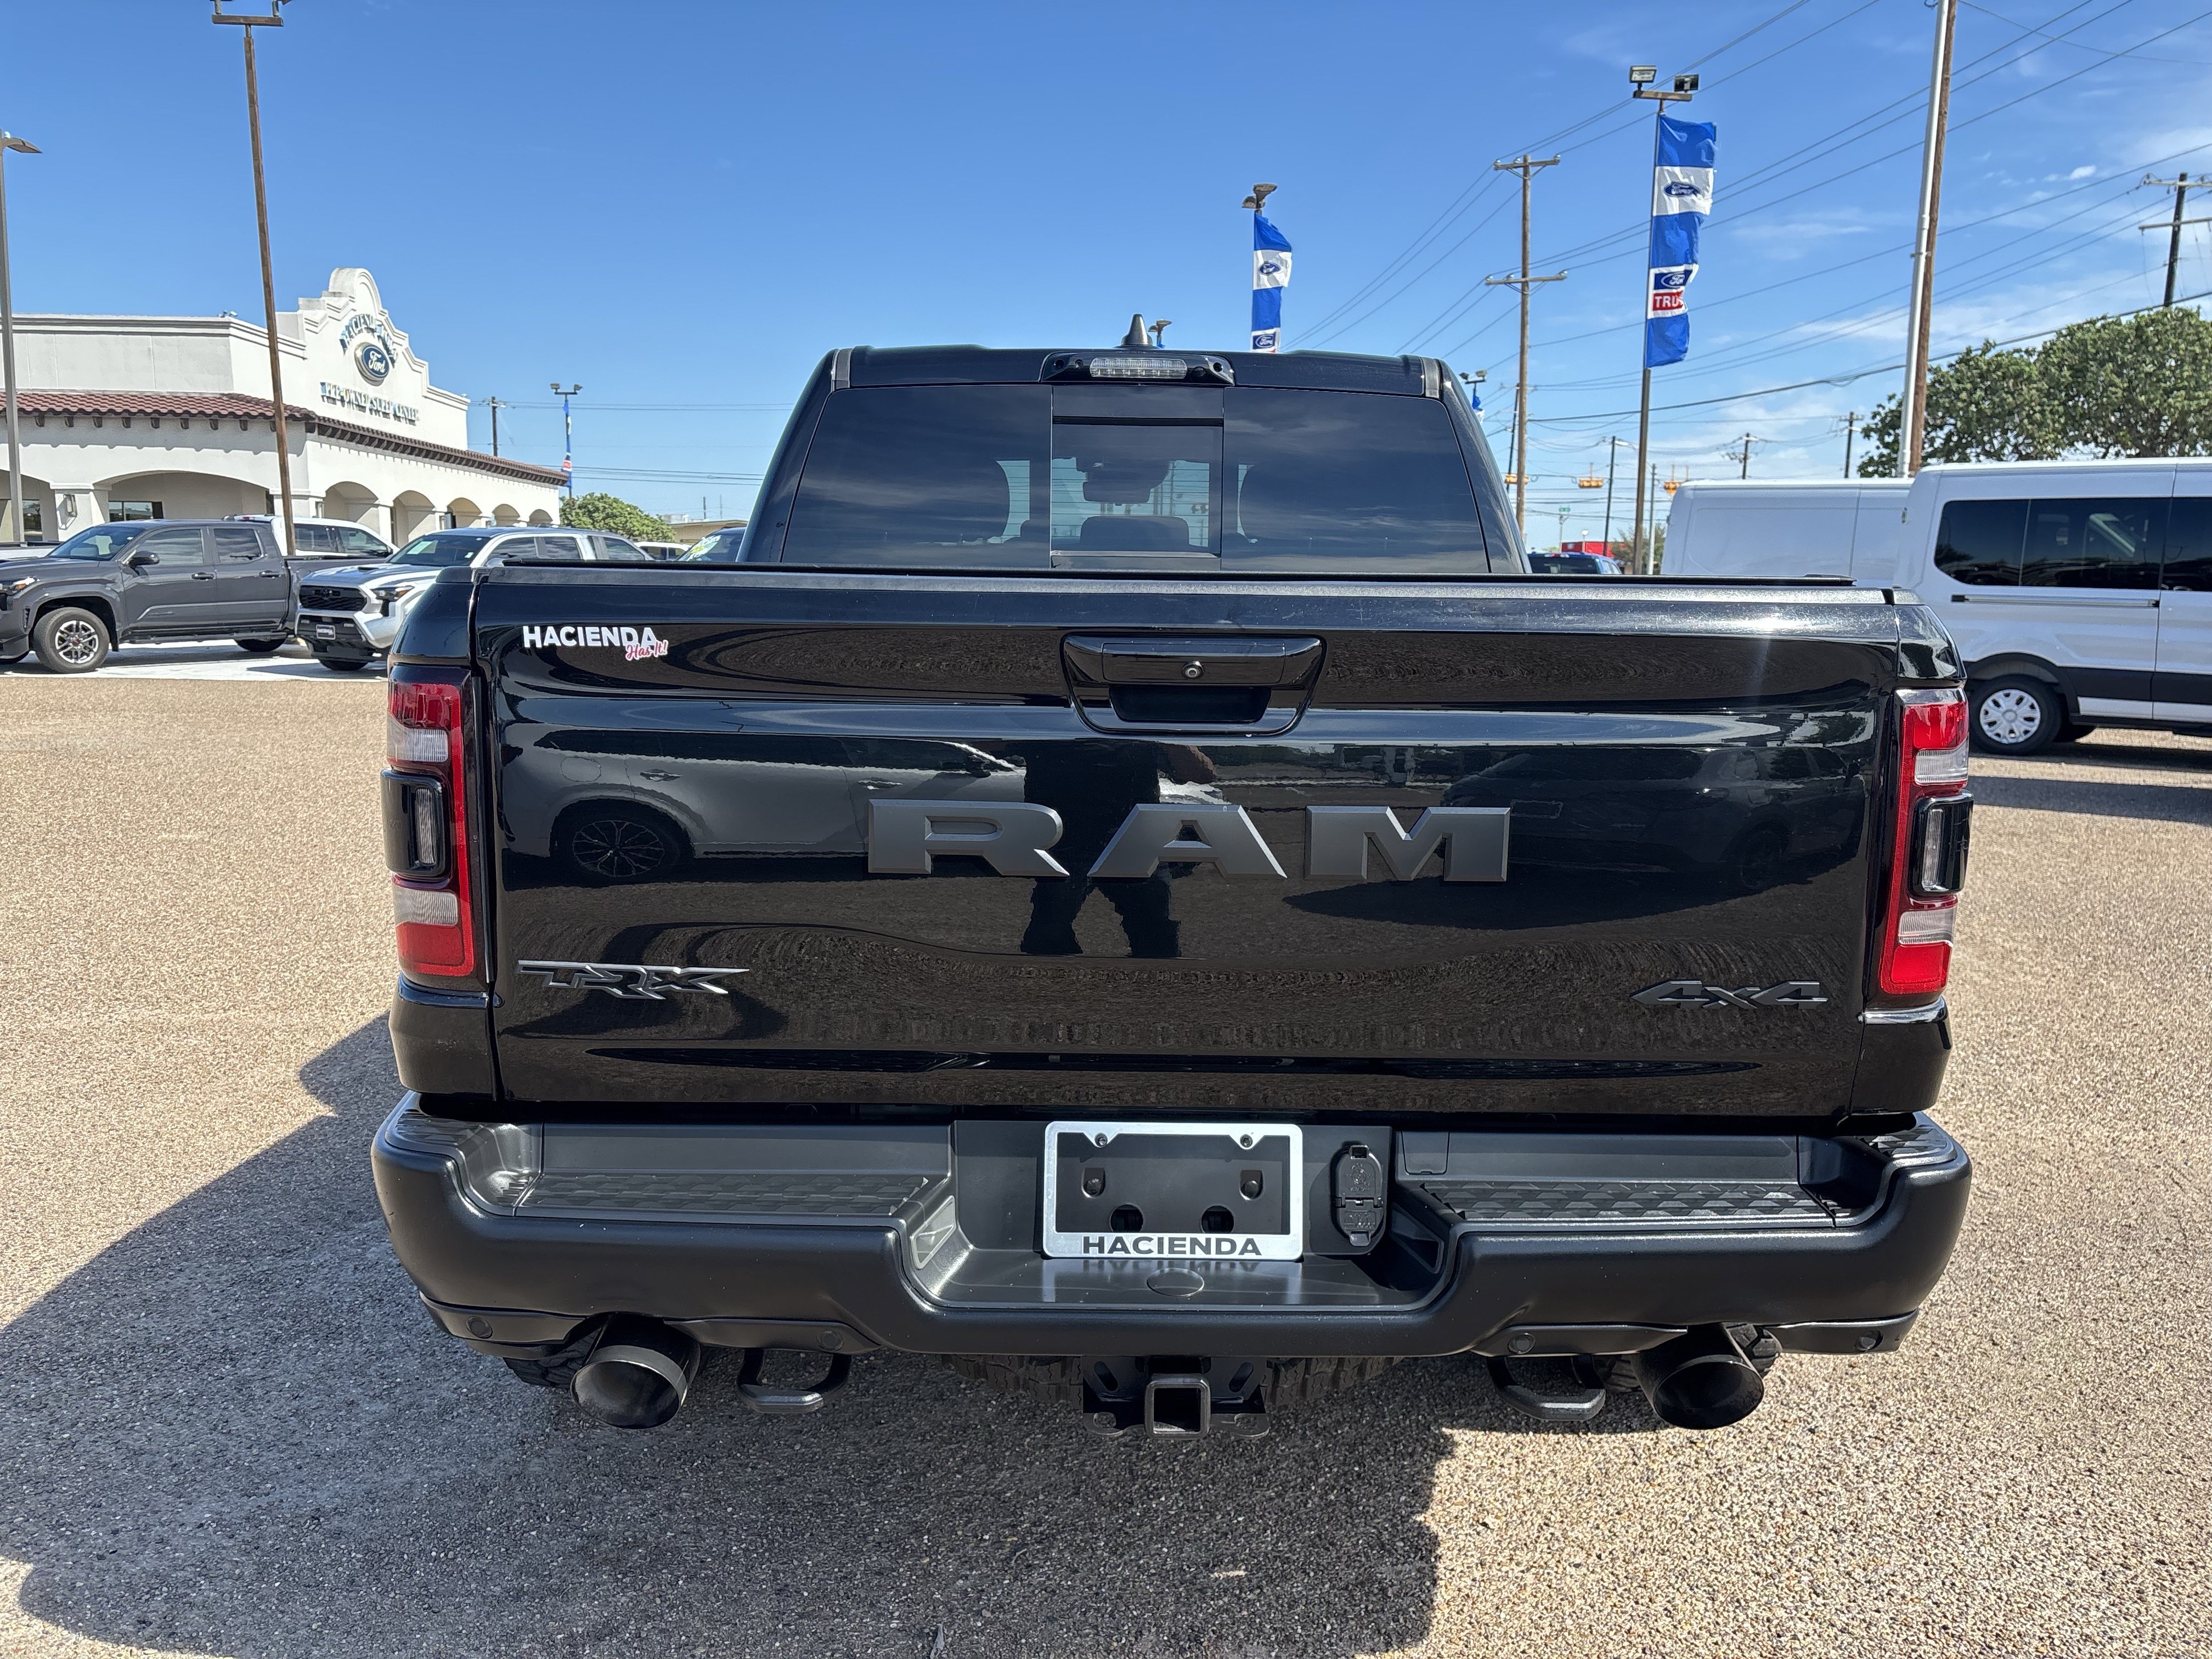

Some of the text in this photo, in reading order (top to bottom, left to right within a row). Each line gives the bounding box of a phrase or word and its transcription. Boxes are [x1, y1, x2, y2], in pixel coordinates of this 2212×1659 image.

[369, 351, 386, 373] Ford
[523, 625, 657, 648] HACIENDA
[627, 641, 667, 660] Has It!
[868, 798, 1511, 881] RAM
[516, 960, 750, 1000] TRX
[1083, 1236, 1262, 1256] HACIENDA
